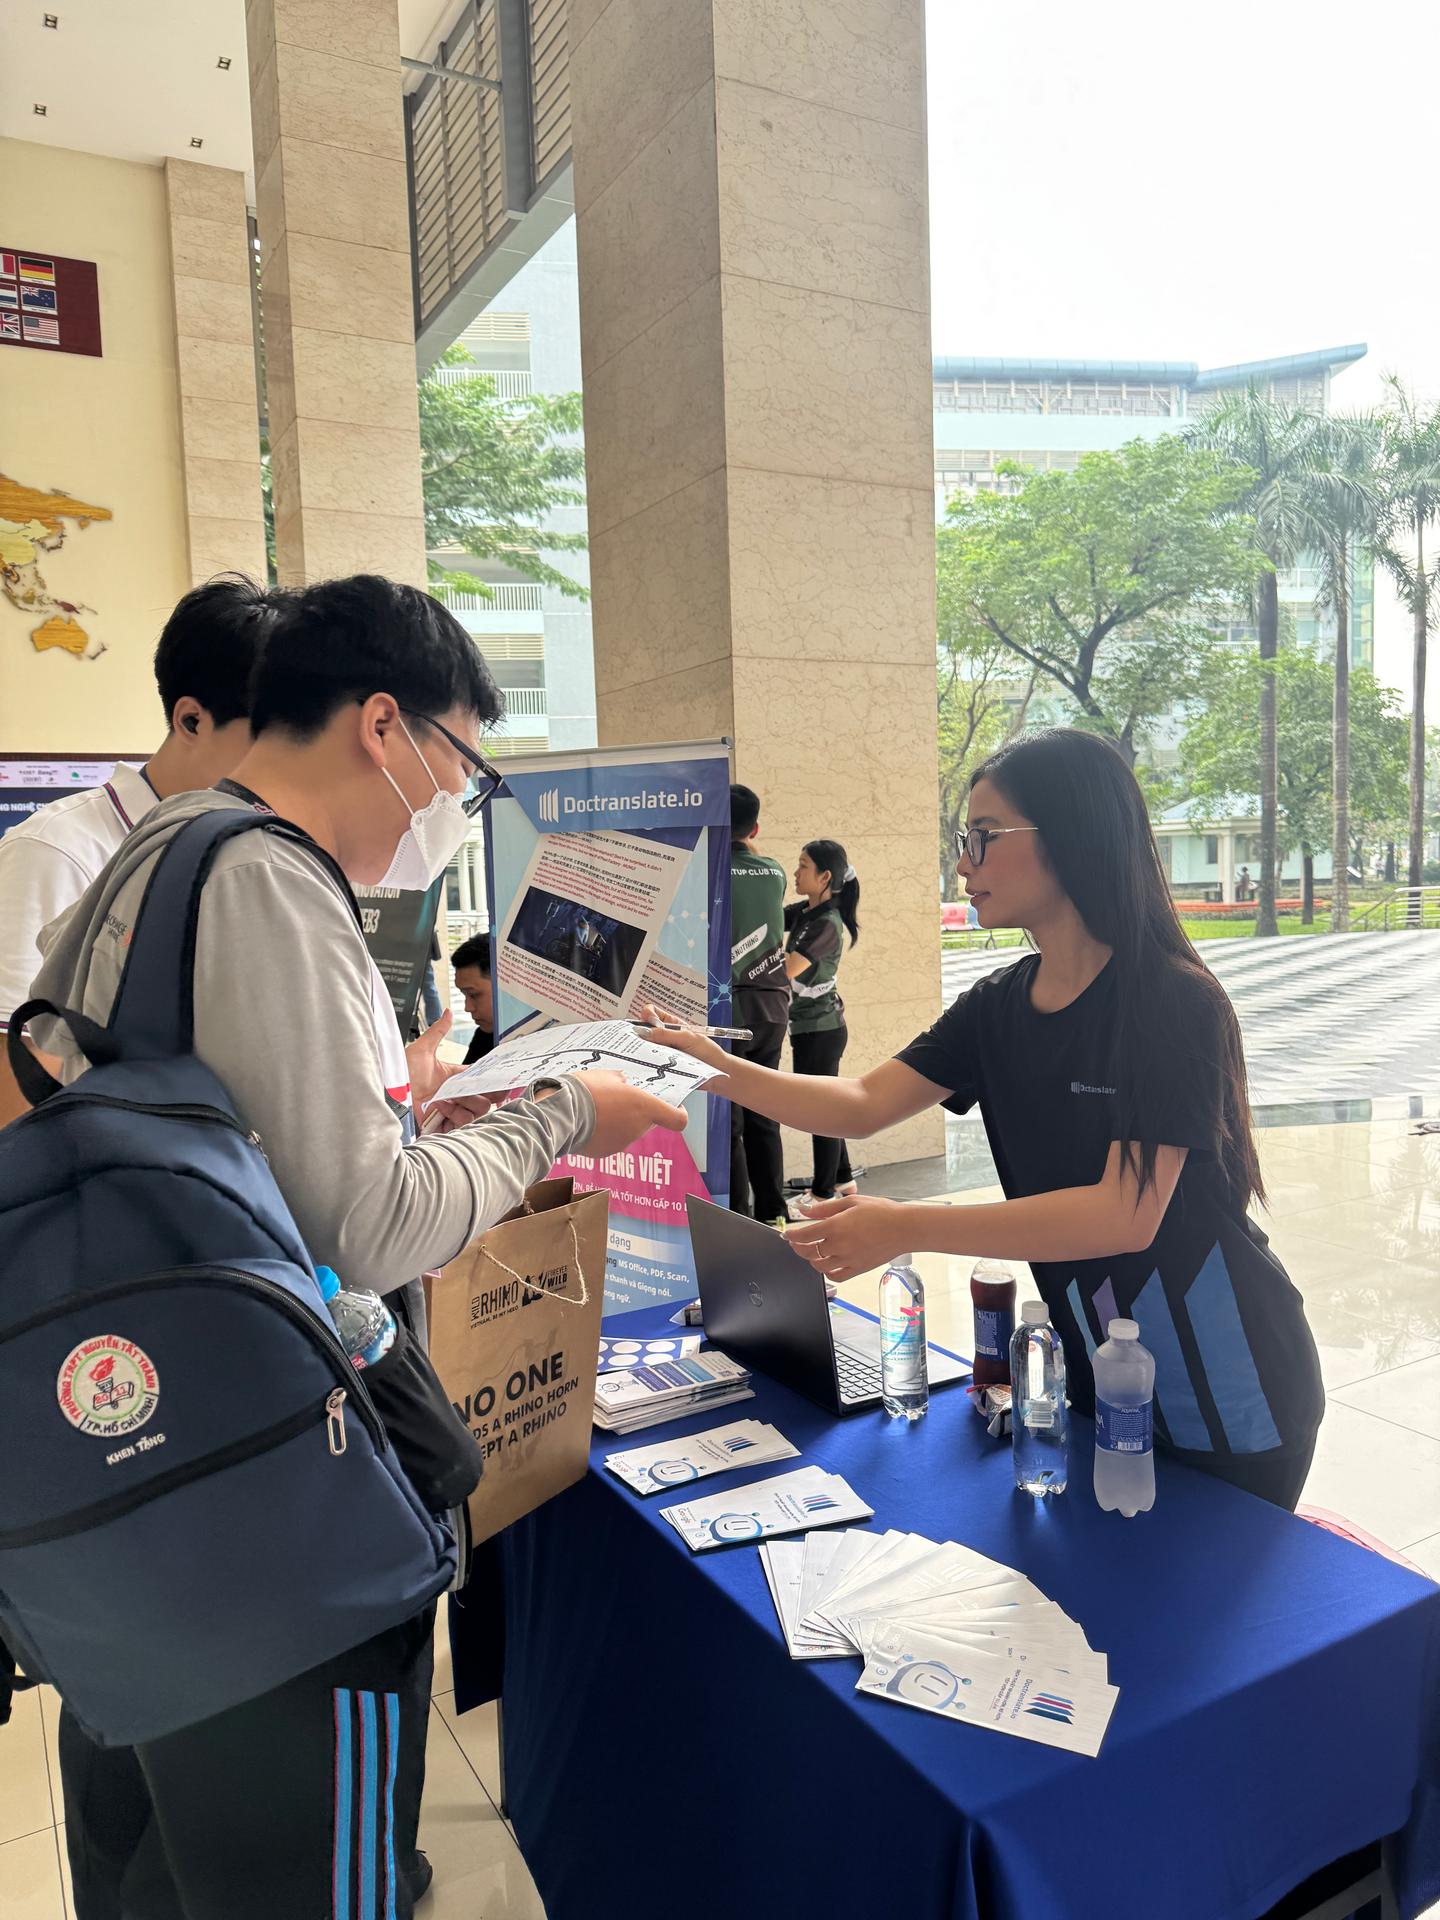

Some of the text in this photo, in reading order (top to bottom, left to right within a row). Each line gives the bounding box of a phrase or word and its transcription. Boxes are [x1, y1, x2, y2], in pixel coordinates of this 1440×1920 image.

[563, 788, 703, 814] Doctranslate.io
[748, 868, 769, 876] CLUB
[360, 907, 381, 934] EB3
[735, 934, 759, 958] NOTHING
[748, 960, 770, 981] EXCEPT
[638, 1152, 673, 1190] VIỆT
[610, 1189, 620, 1200] VÀ
[620, 1191, 633, 1203] TỐT
[634, 1195, 651, 1207] HƠN
[652, 1197, 670, 1209] GẤP
[671, 1202, 682, 1211] 10
[609, 1233, 631, 1251] dạng
[547, 1273, 568, 1288] WILD
[609, 1274, 628, 1286] thanh
[618, 1259, 628, 1269] MS
[628, 1262, 650, 1276] Office,
[650, 1268, 666, 1280] PDF,
[666, 1272, 690, 1284] Scan,
[481, 1280, 519, 1316] RHINO
[604, 1289, 616, 1300] ong
[471, 1295, 480, 1321] WILD
[95, 1393, 109, 1404] 20
[452, 1351, 563, 1425] NO ONE
[492, 1418, 501, 1432] A
[504, 1396, 543, 1426] RHINO
[547, 1376, 579, 1403] HORN
[481, 1435, 503, 1460] EPT
[508, 1429, 519, 1446] A
[523, 1401, 567, 1438] RHINO
[106, 1433, 166, 1465] KHEN TẶNG
